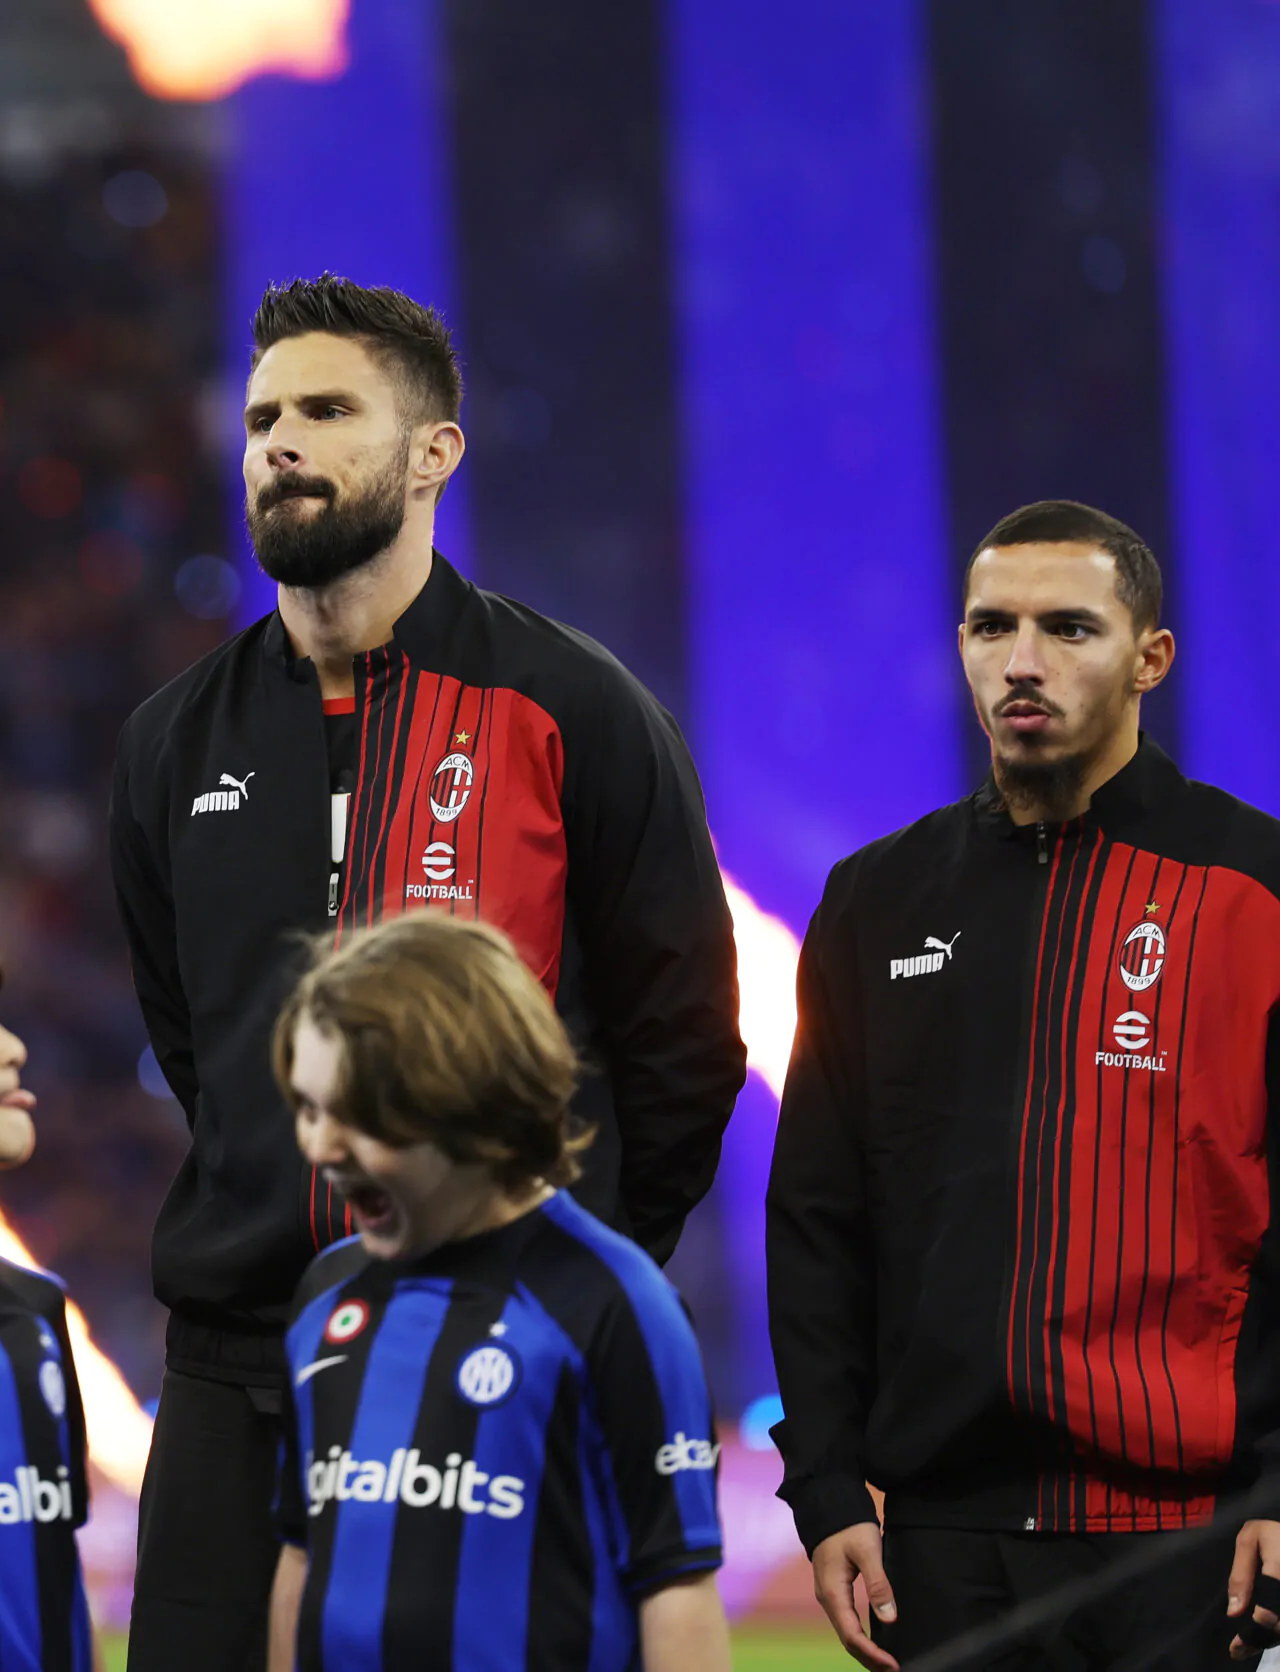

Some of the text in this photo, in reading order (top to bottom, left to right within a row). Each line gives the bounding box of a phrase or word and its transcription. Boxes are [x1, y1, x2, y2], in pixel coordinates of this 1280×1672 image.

[442, 755, 471, 772] ACM
[190, 790, 240, 817] PUMA
[435, 806, 458, 818] 1899
[405, 884, 473, 900] FOOTBALL
[1132, 924, 1161, 939] ACM
[890, 952, 945, 980] PUMA
[1127, 975, 1151, 987] 1899
[1095, 1051, 1167, 1072] FOOTBALL
[306, 1445, 525, 1519] gitalbits
